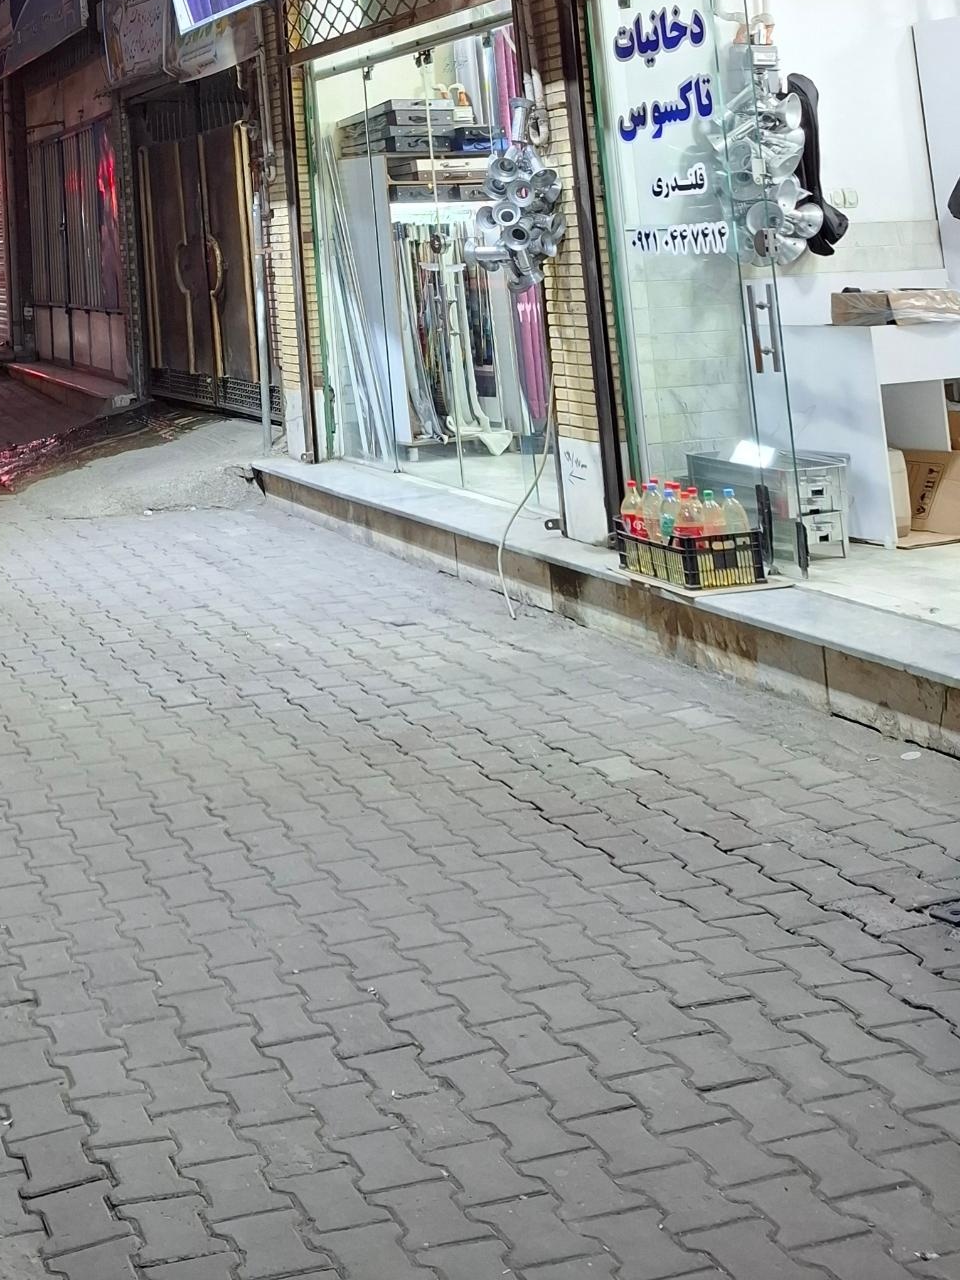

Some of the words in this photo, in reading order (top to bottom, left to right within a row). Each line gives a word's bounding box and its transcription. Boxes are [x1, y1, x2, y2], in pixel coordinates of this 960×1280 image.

[614, 5, 705, 66] دخانیات
[619, 76, 713, 142] تاکسوس
[651, 168, 706, 199] قلندری
